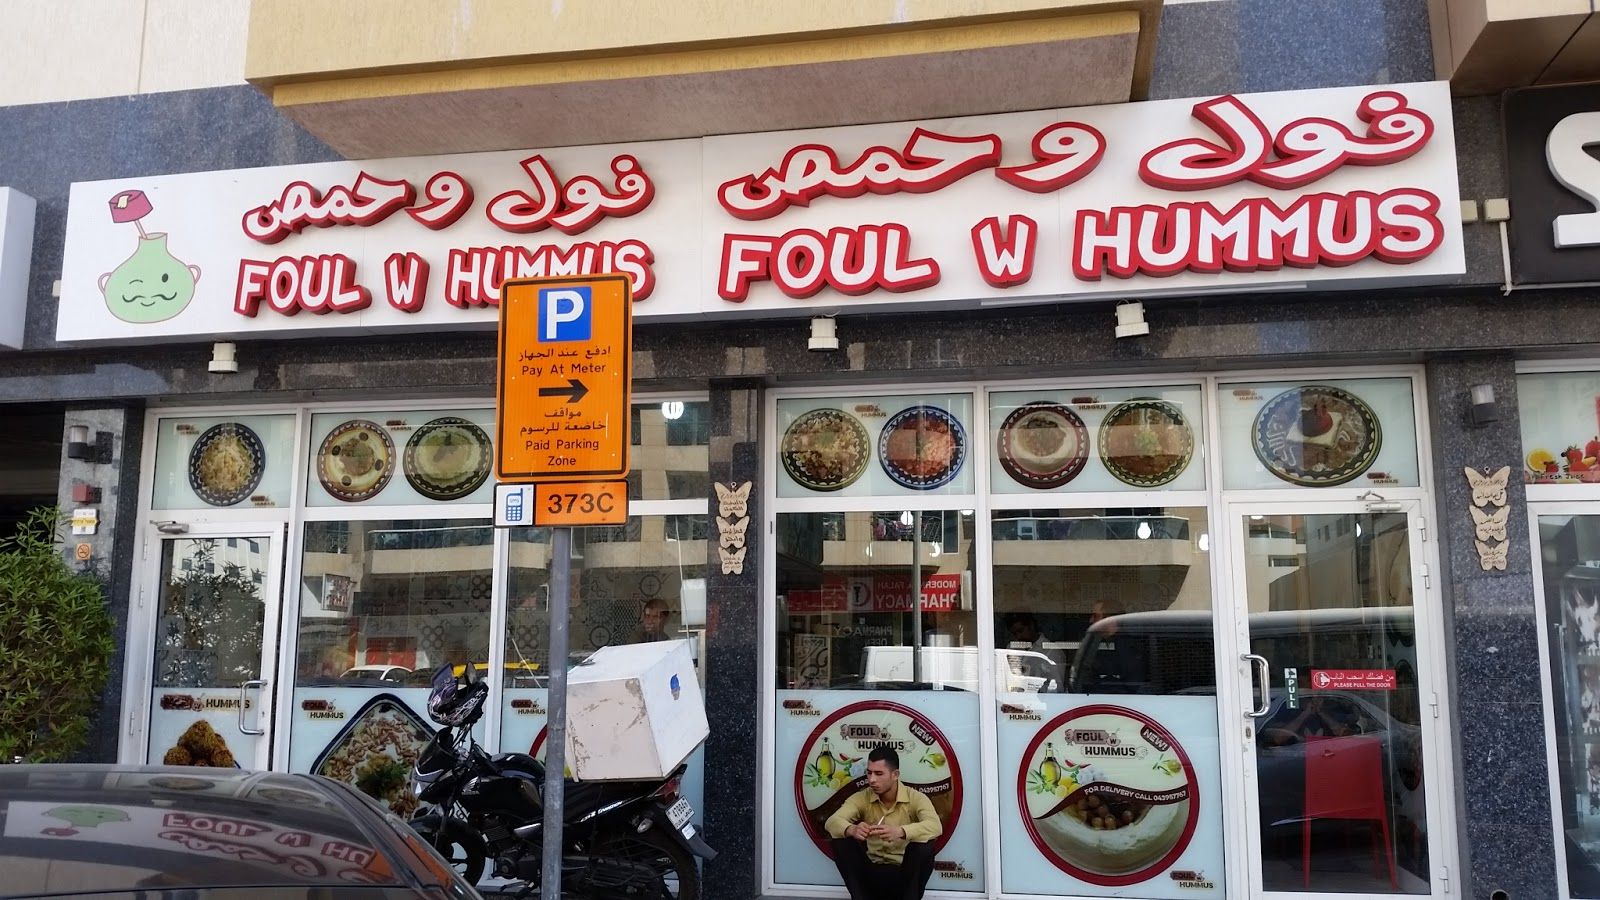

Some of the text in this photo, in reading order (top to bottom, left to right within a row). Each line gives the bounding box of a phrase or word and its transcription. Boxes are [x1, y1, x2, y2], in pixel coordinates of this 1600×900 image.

[1139, 91, 1434, 190] فول
[486, 154, 656, 236] فول
[718, 187, 1444, 301] FOUL W HUMMUS
[234, 253, 371, 318] FOUL
[384, 252, 431, 313] W
[545, 290, 585, 340] P
[518, 345, 611, 362] ادفع عند الجهاز
[521, 362, 607, 377] Pay At Meter
[544, 406, 582, 420] مواقف
[519, 420, 607, 437] خاضعة للرسوم
[525, 438, 600, 451] Paid Parking
[547, 455, 577, 467] Zone
[547, 492, 615, 515] 373C
[1288, 680, 1297, 709] PULL
[850, 727, 876, 736] FOUL
[911, 723, 934, 745] NEW!
[1076, 732, 1104, 741] FOUL
[1143, 729, 1168, 750] NEW!
[1084, 746, 1136, 757] HUMMUS
[1084, 785, 1100, 795] FOR
[1100, 785, 1135, 798] DELIVERY
[1134, 792, 1153, 801] CALL
